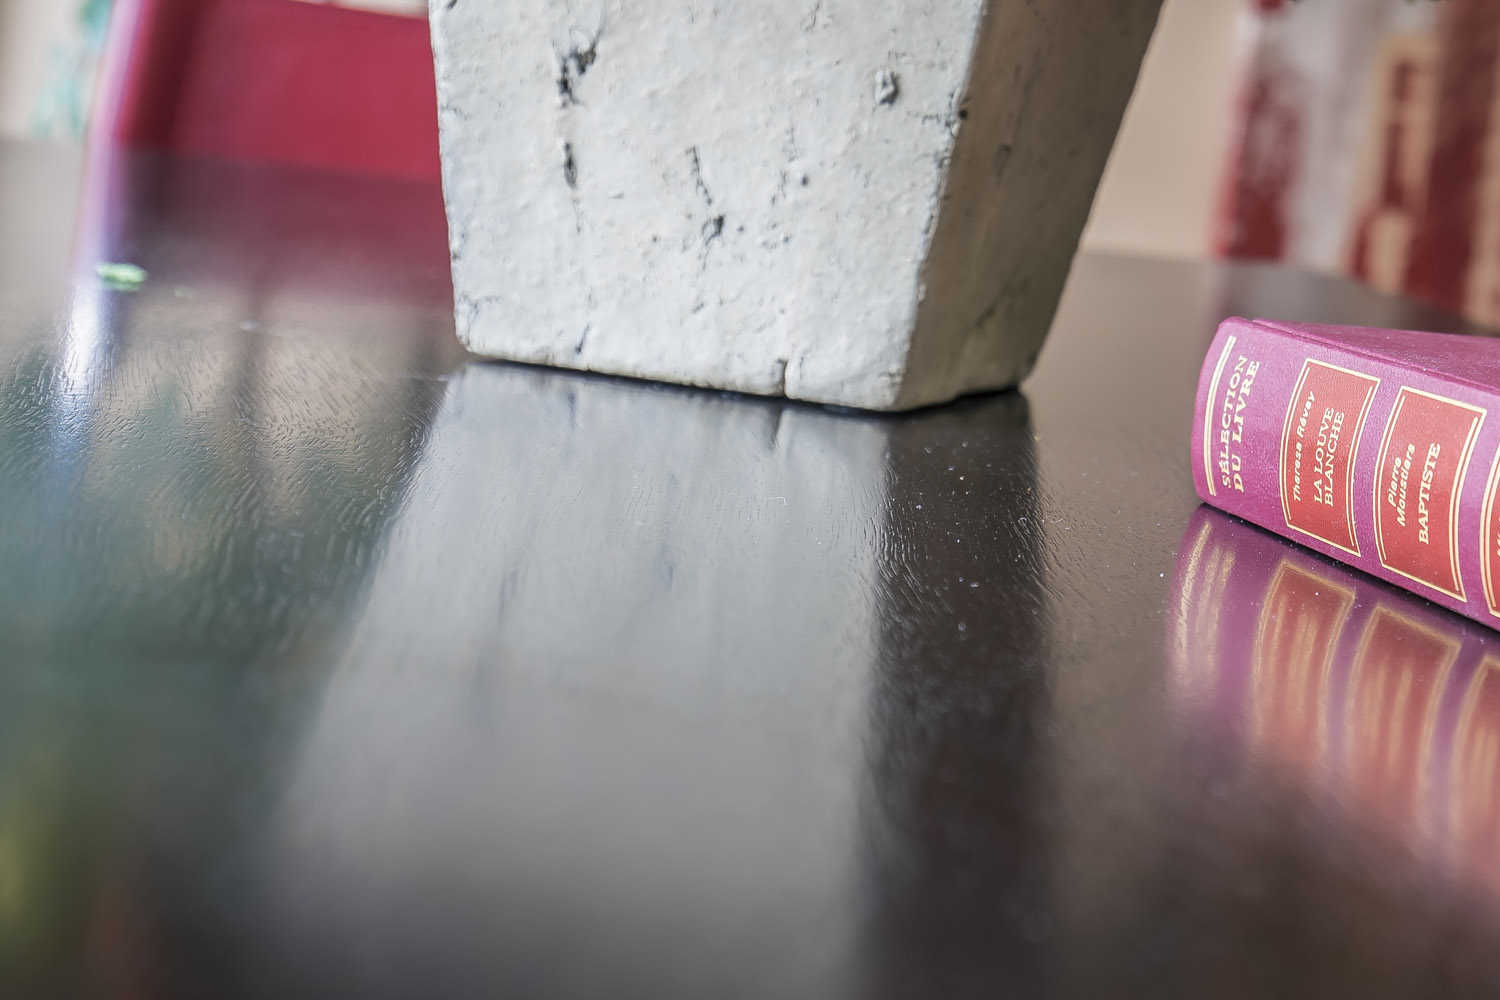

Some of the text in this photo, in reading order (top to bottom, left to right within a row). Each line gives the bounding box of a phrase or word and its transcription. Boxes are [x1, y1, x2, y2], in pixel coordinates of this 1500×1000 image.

[1219, 355, 1248, 488] SÉLECTION
[1232, 360, 1260, 492] DU LIVRE
[1296, 391, 1315, 438] Révay
[1314, 407, 1334, 504] LA LOUVE
[1325, 411, 1345, 507] BLANCHE
[1388, 456, 1402, 507] Pierre
[1397, 443, 1415, 527] Moustiers
[1418, 443, 1441, 545] BAPTISTE
